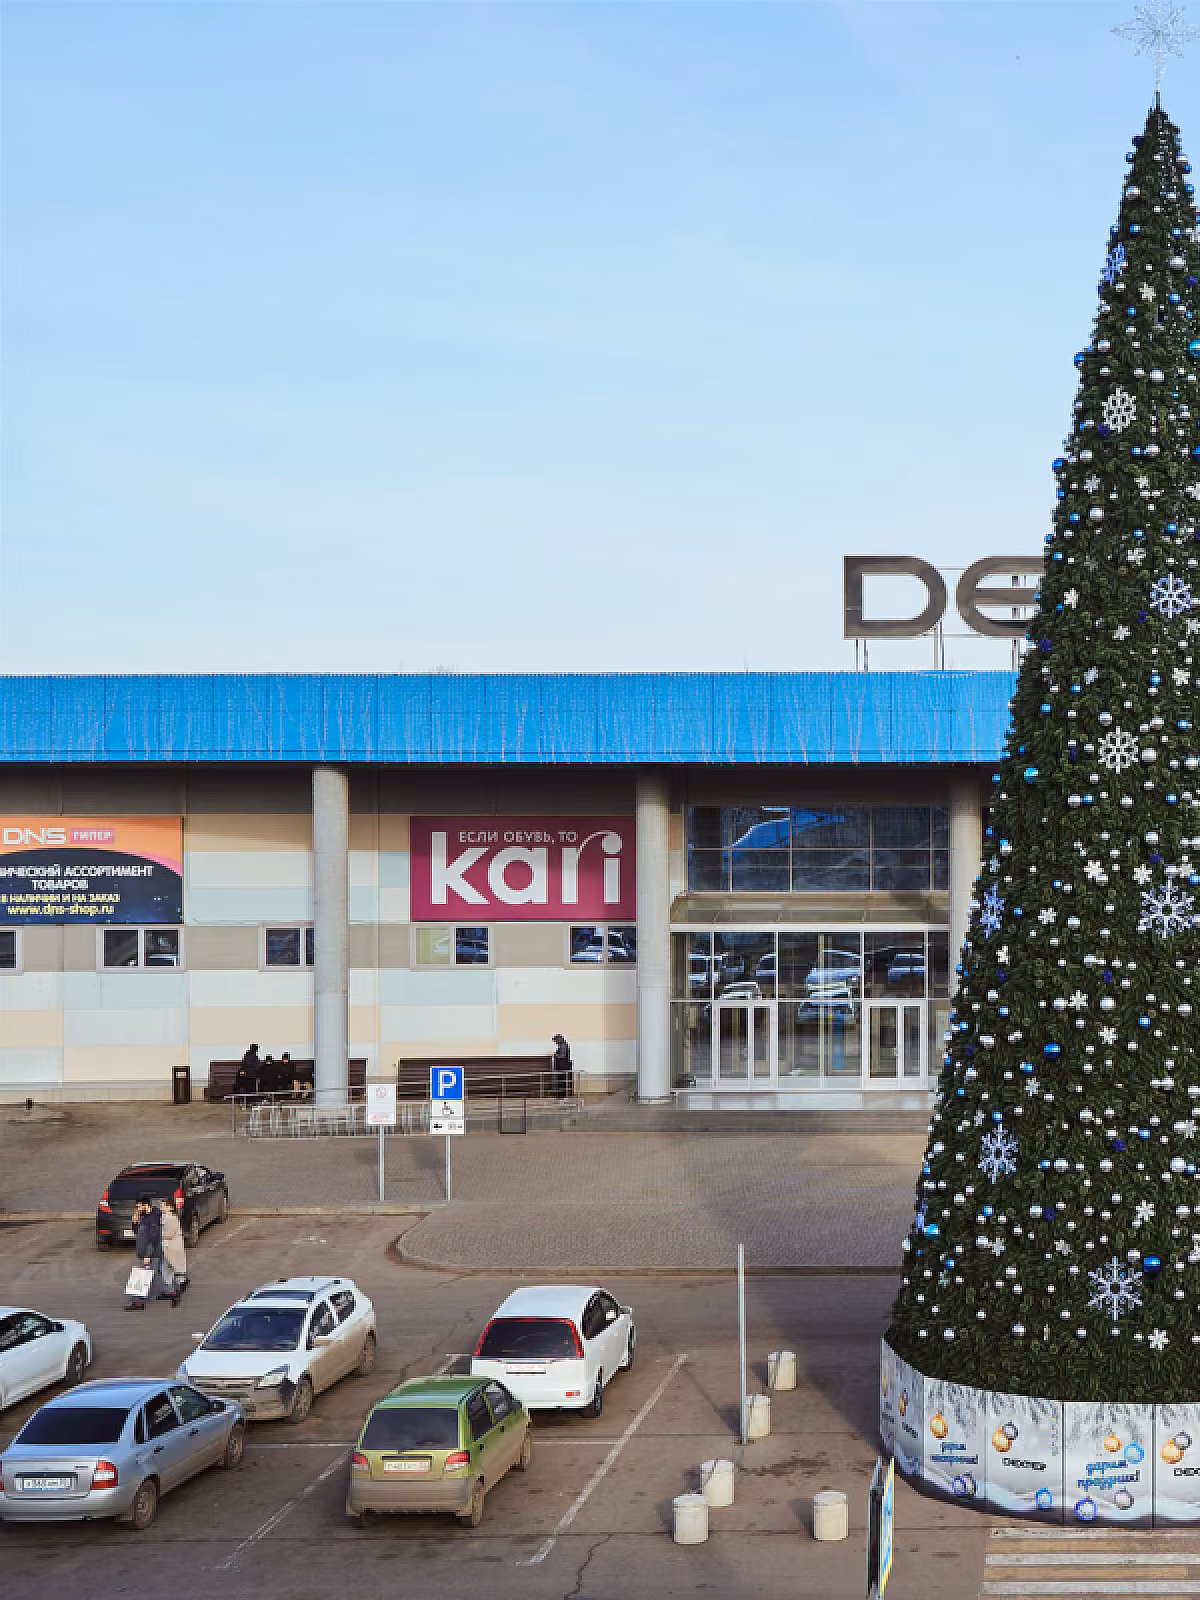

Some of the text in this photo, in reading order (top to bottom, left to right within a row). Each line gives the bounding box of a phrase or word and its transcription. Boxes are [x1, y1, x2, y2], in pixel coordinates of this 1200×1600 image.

[3, 827, 67, 845] DNS
[459, 831, 498, 843] ЕСЛИ
[558, 831, 578, 842] ТО
[64, 866, 153, 877] АССОРТИМЕНТ
[431, 831, 622, 905] kari
[31, 879, 89, 890] ТОВАРОВ
[7, 904, 115, 917] www.dns-shop.ru
[438, 1070, 457, 1097] P
